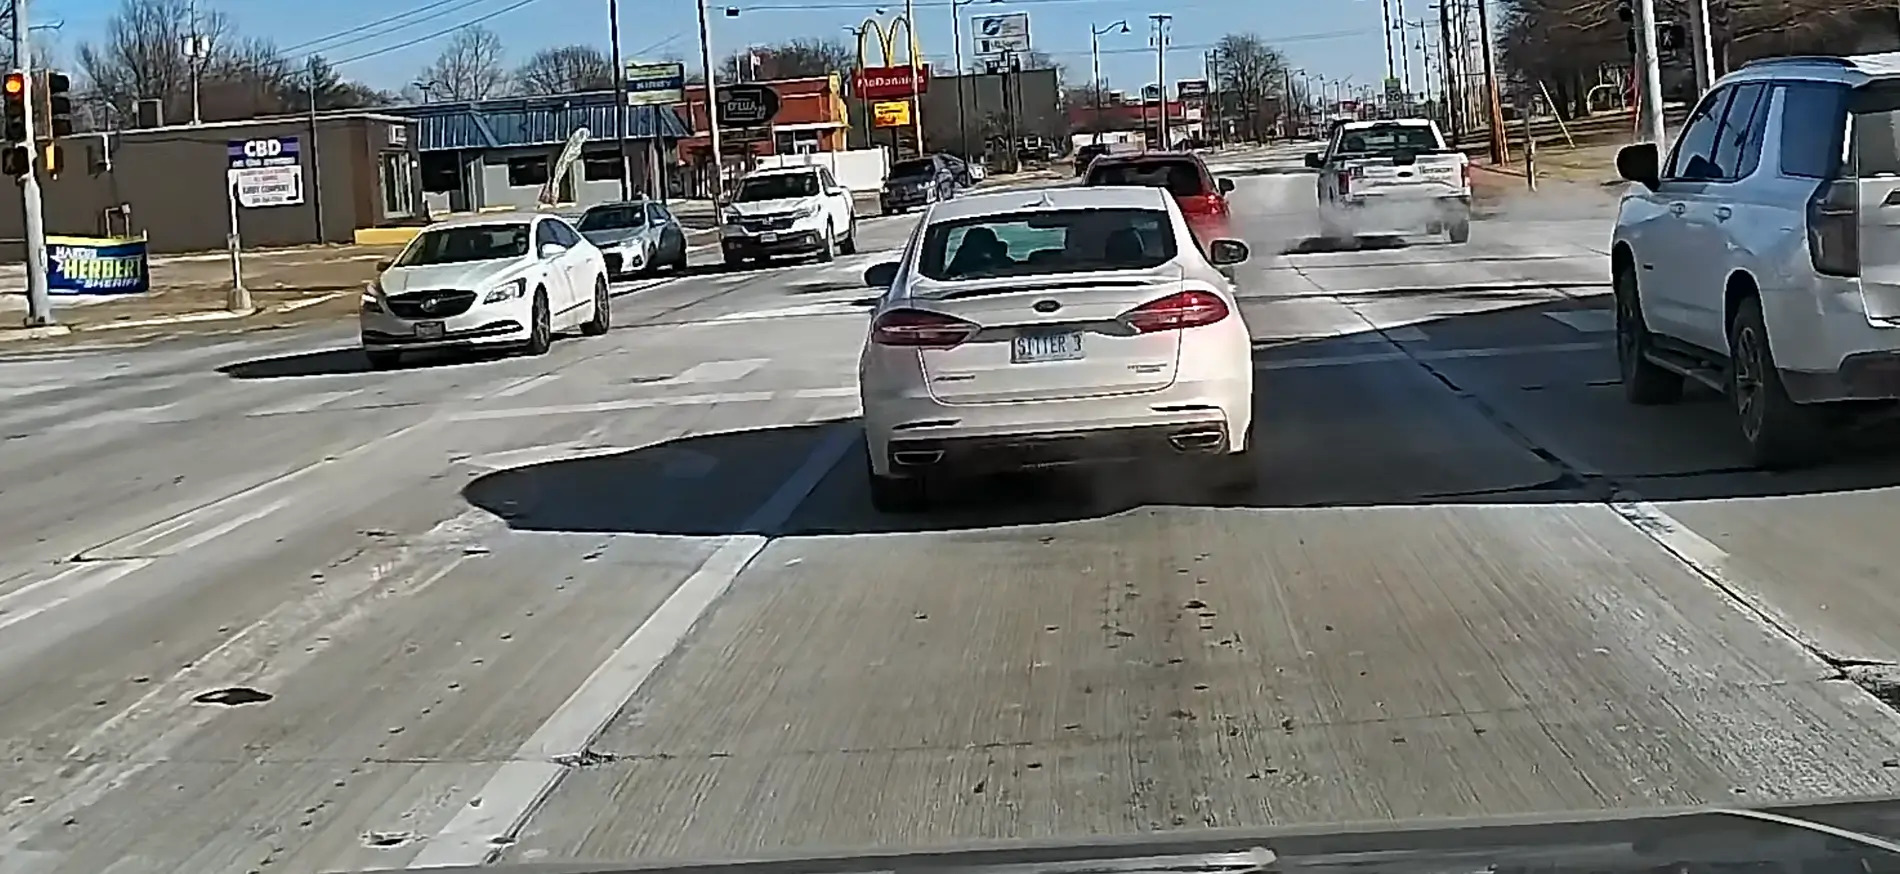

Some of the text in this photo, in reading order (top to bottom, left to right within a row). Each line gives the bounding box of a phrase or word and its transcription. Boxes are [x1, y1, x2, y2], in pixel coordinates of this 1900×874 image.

[244, 139, 281, 157] CBD
[63, 257, 143, 280] HERBERT
[83, 278, 140, 289] SHERIFF
[1017, 336, 1066, 356] SITTER
